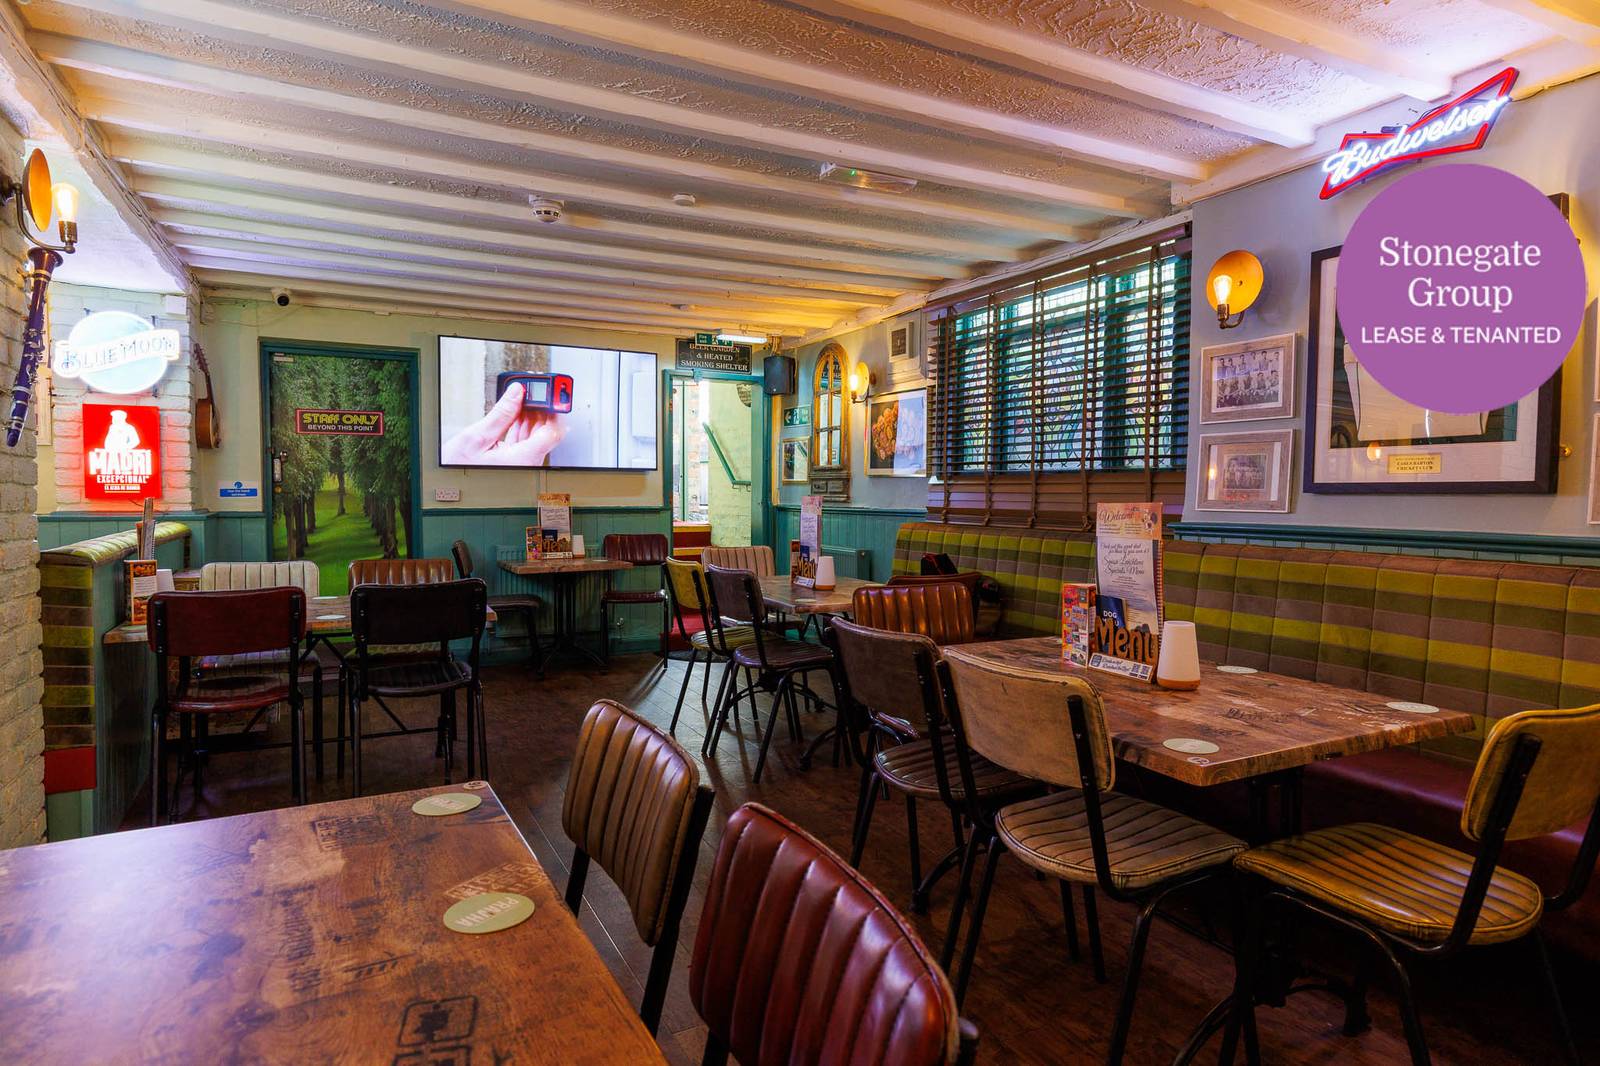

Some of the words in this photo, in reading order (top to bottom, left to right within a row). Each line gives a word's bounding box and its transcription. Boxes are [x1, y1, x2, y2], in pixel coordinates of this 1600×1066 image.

[1321, 95, 1511, 185] Budweiser
[704, 353, 733, 361] HEATED
[681, 360, 715, 369] SMOKING
[715, 362, 748, 371] SHELTER
[302, 413, 340, 424] STAFF
[342, 414, 379, 425] ONLY
[1103, 610, 1118, 619] DOG
[1094, 615, 1159, 668] Menu
